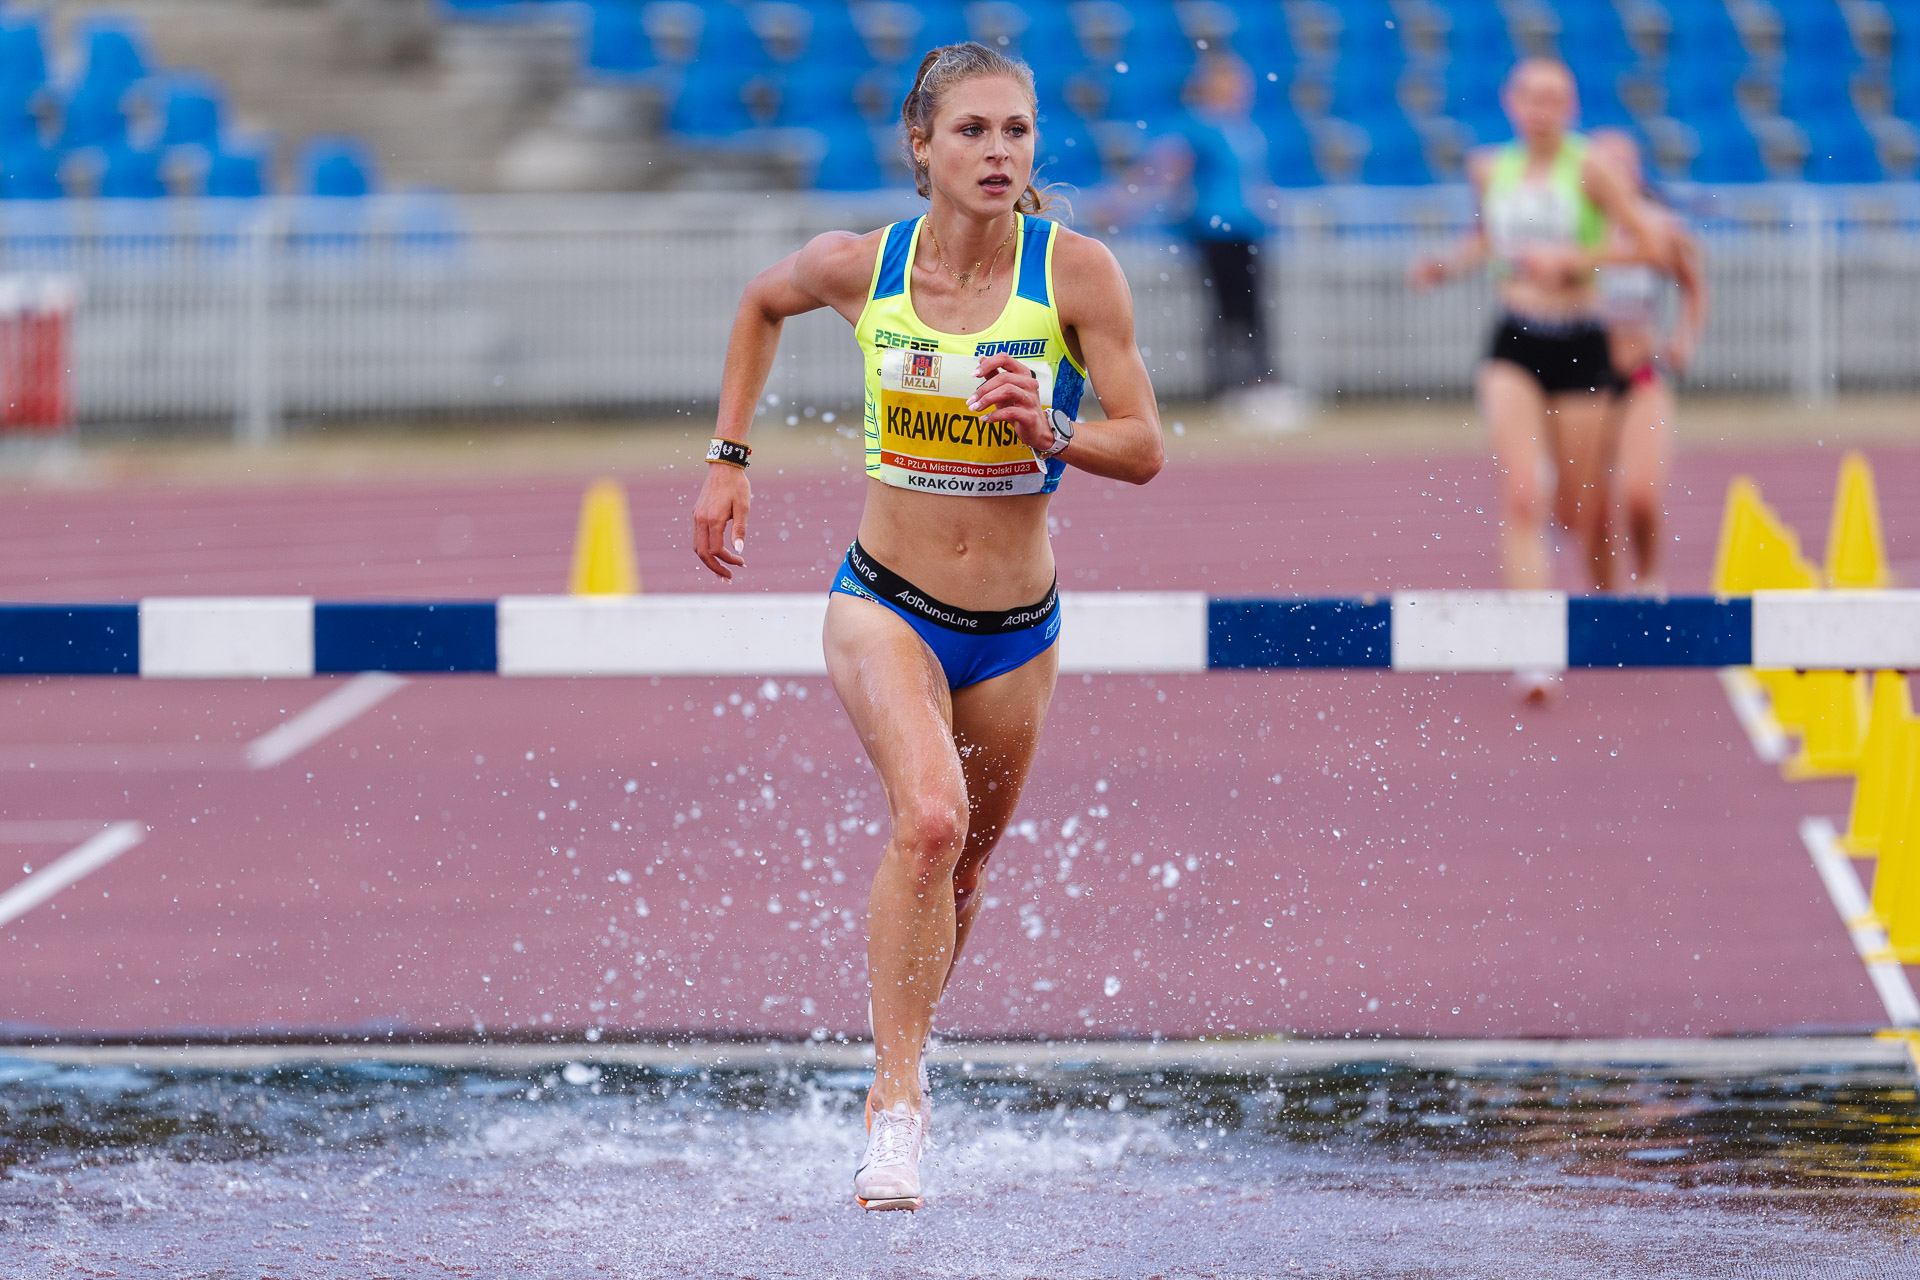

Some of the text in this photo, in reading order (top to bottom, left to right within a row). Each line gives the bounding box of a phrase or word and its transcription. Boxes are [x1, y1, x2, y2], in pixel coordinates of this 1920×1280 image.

[974, 340, 1048, 358] SONAROL
[904, 376, 937, 389] MZLA
[887, 405, 1024, 447] KRAWCZYNS
[894, 456, 1031, 476] 42. PZLA Mistrzostwa Polski U23
[908, 474, 1013, 491] KRAKÓW 2025
